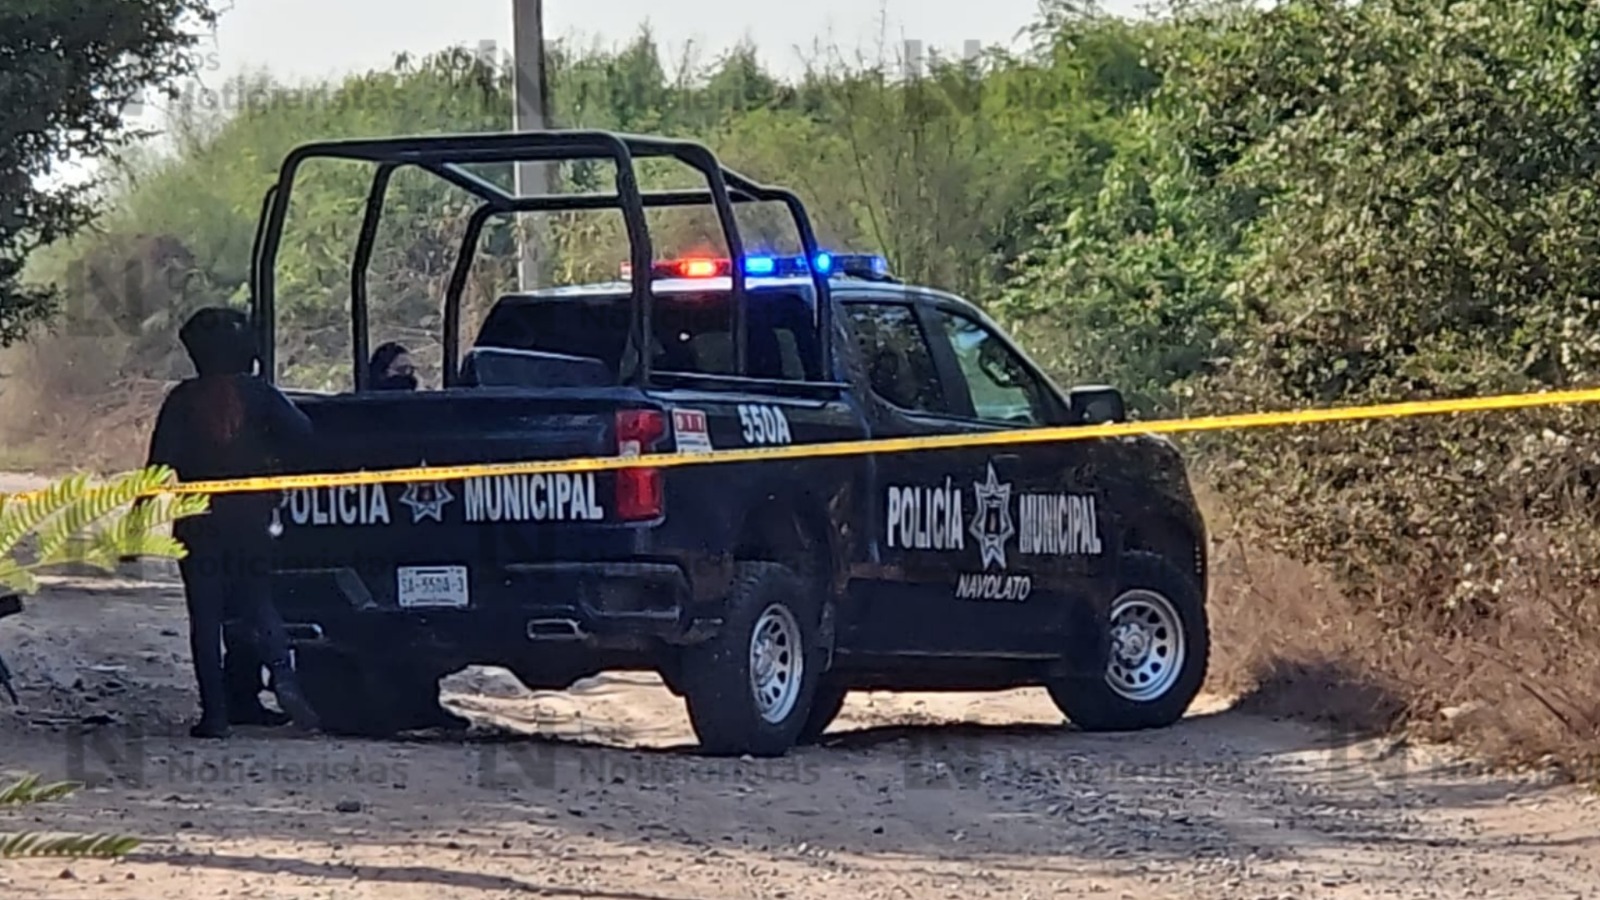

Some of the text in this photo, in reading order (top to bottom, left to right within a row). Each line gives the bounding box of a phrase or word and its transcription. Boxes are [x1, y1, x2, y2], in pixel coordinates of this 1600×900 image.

[738, 404, 792, 443] 550A
[465, 472, 604, 522] MUNICIPAL
[1019, 492, 1102, 554] MUNICIPAL
[956, 573, 1032, 600] NAVOLATO
